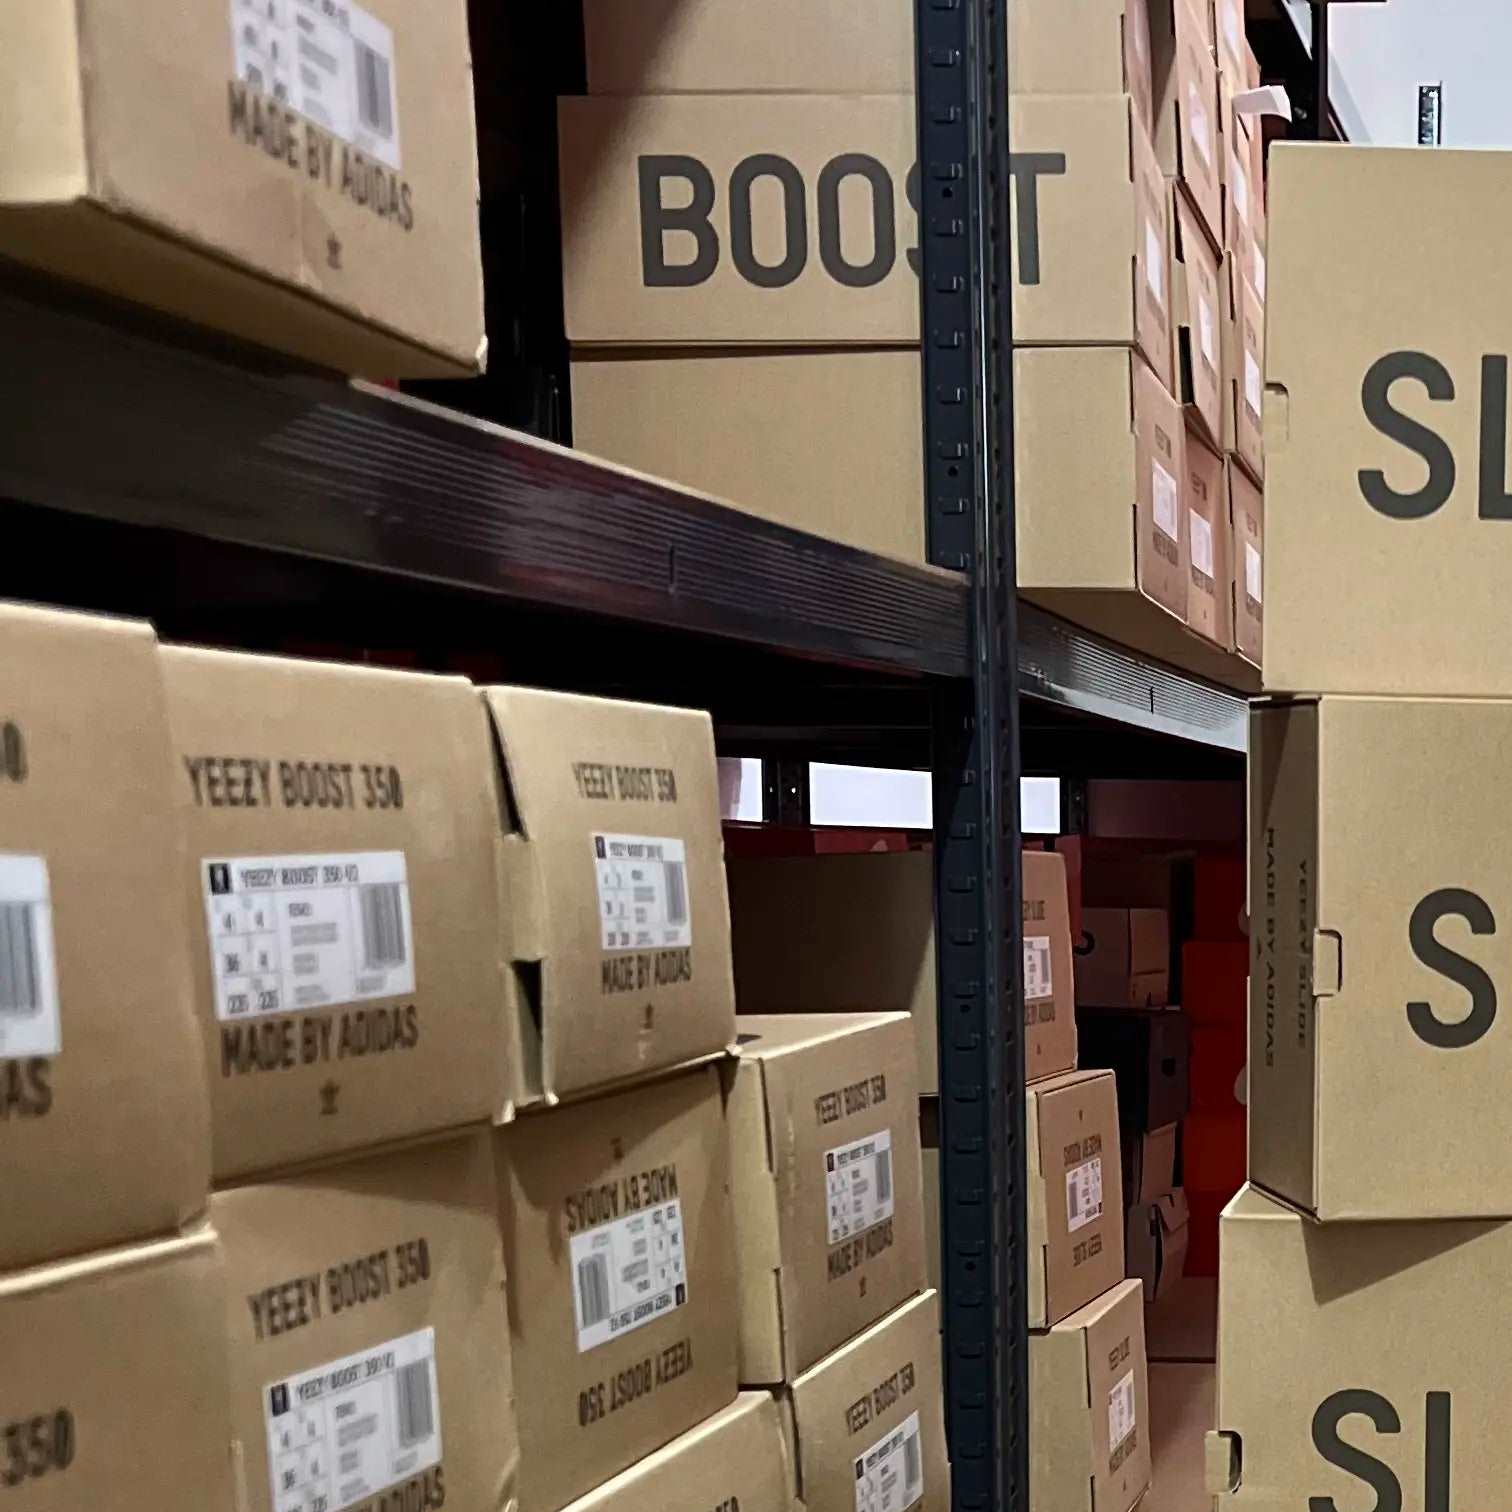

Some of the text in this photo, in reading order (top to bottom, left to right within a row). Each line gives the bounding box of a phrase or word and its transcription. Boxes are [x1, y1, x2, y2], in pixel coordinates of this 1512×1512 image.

[183, 753, 404, 810] YEEZY BOOST 350
[571, 762, 616, 801] YEEZY
[616, 765, 655, 802] BOOST
[1265, 828, 1276, 1067] MADE BY ADIDAS
[221, 1004, 419, 1078] MADE BY ADIDAS
[247, 1236, 432, 1344] YEEZY BOOST 350
[578, 1336, 695, 1428] YEEZY BOOST 350
